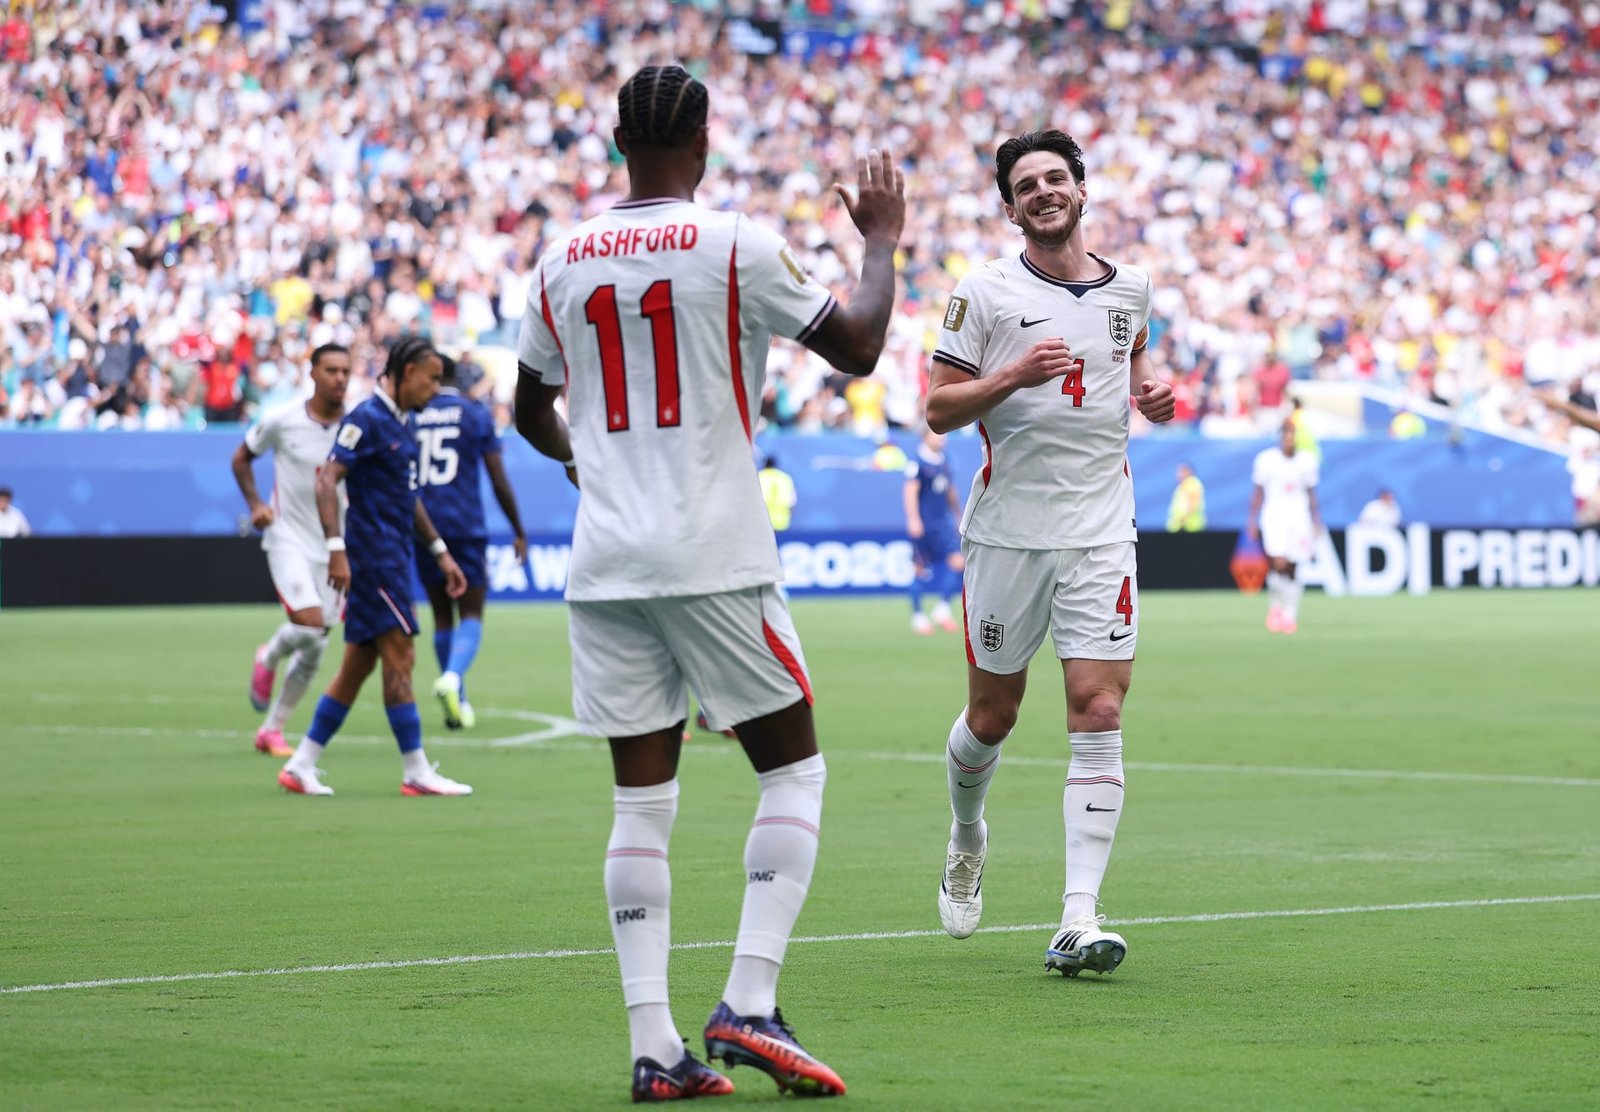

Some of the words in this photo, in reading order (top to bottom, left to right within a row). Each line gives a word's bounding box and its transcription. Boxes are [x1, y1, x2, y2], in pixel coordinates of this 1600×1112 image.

[566, 223, 698, 265] RASHFORD
[584, 279, 681, 433] 11
[1061, 358, 1086, 408] 4
[416, 426, 461, 486] 15
[780, 540, 915, 588] 2026
[1297, 522, 1431, 597] ADI
[1443, 529, 1600, 589] PREDI
[1116, 576, 1133, 625] 4
[615, 907, 646, 925] ENG
